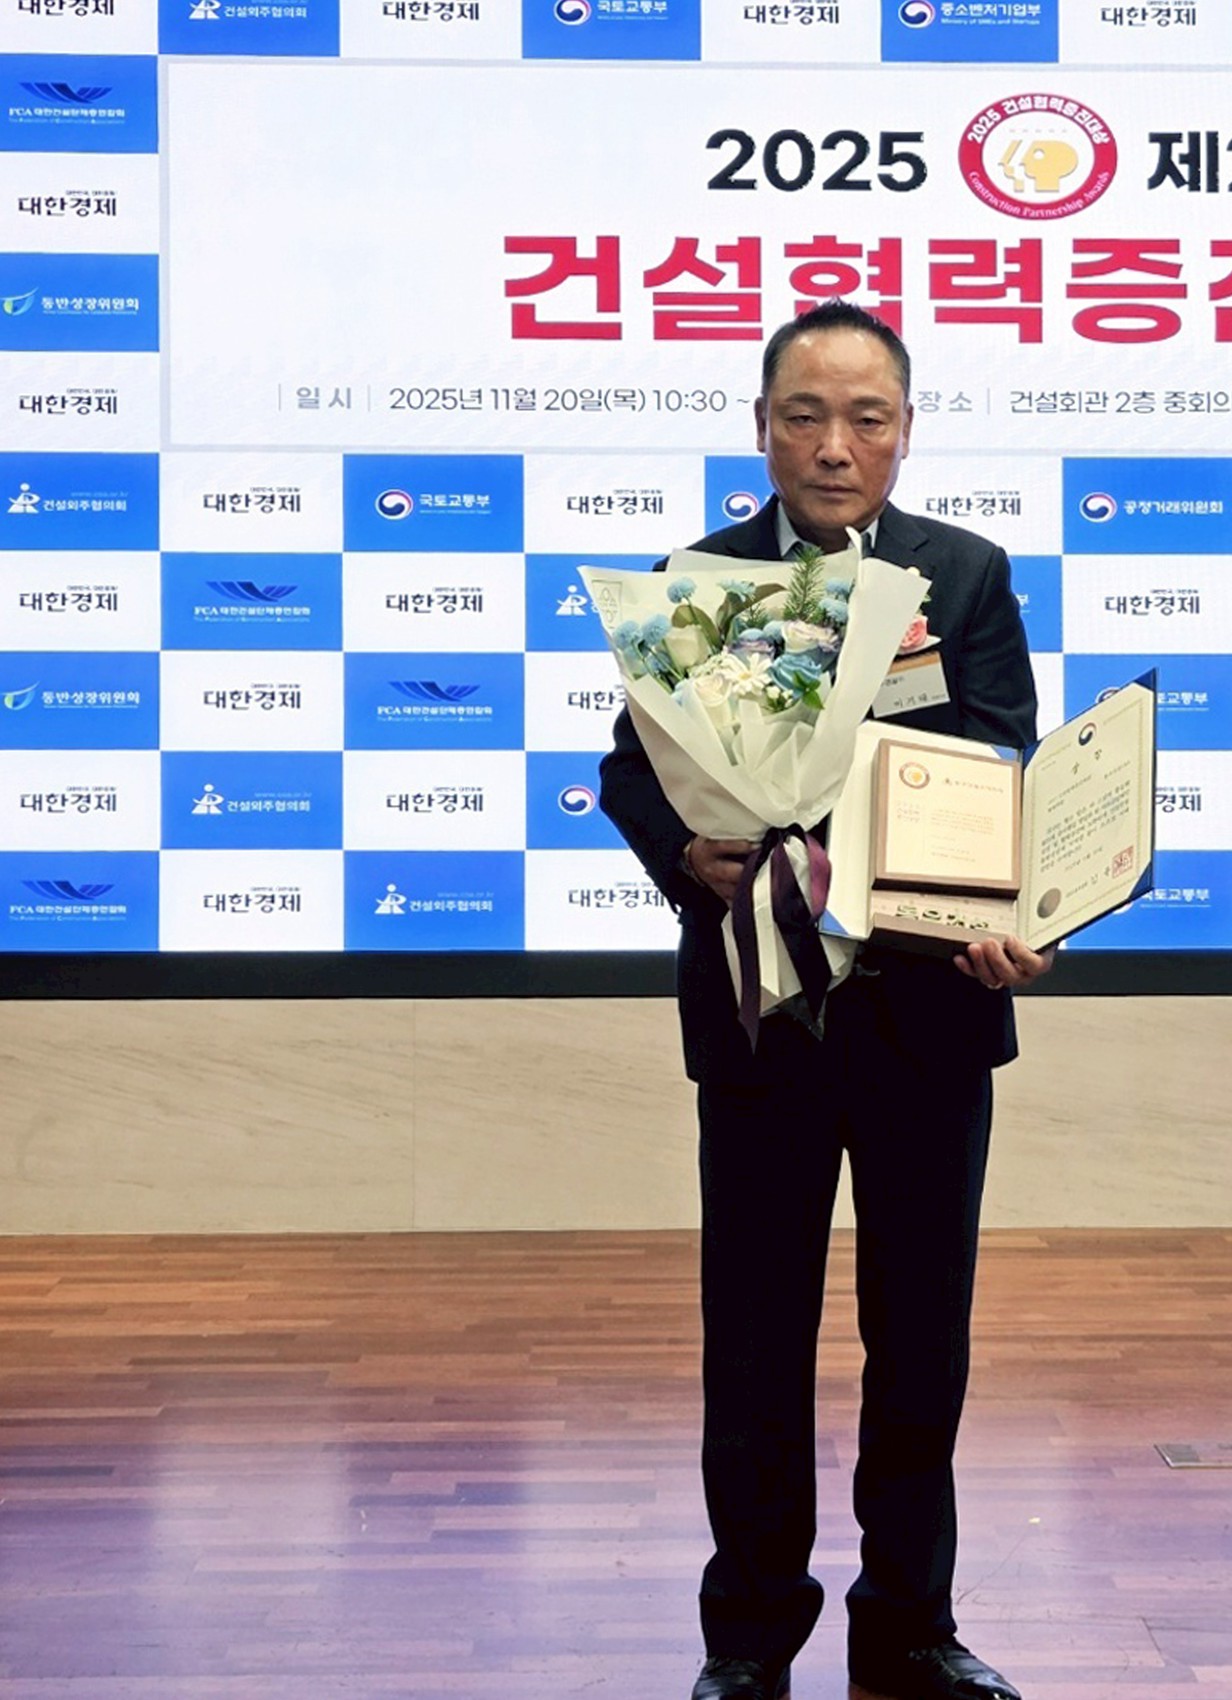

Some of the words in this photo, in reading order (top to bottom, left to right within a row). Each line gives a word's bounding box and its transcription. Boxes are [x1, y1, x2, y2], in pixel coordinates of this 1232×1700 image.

[19, 0, 113, 16] 대한경제
[224, 6, 307, 18] 건설외주협의회
[383, 3, 479, 21] 대한경제
[598, 0, 667, 13] 국토교통부
[744, 5, 839, 25] 대한경제
[941, 3, 1041, 16] 중소벤처기업부
[1102, 7, 1196, 26] 대한경제
[967, 108, 1001, 144] 2025
[1001, 95, 1110, 144] 건설협력증진대상
[706, 129, 927, 192] 2025
[970, 172, 1021, 215] Construction
[1022, 198, 1084, 217] Partnership
[1083, 171, 1110, 202] Awards
[19, 197, 116, 217] 대한경제
[42, 298, 139, 312] 동반성장위원회
[20, 395, 117, 415] 대한경제
[390, 388, 482, 410] 2025년
[491, 388, 536, 411] 11월
[544, 389, 645, 412] 20일(목)
[653, 390, 726, 412] 10:30
[1011, 391, 1108, 413] 건설회관
[1116, 391, 1154, 413] 2층
[44, 500, 126, 511] 건설외주협의회
[204, 494, 300, 513] 대한경제
[420, 494, 489, 507] 국토교통부
[566, 494, 664, 515] 대한경제
[926, 497, 1021, 517] 대한경제
[1124, 501, 1223, 514] 공정거래위원회
[20, 592, 117, 612] 대한경제
[194, 606, 218, 615] FCA
[386, 594, 482, 613] 대한경제
[1105, 596, 1199, 616] 대한경제
[43, 692, 140, 704] 동반성장위원회
[204, 691, 300, 710] 대한경제
[377, 706, 400, 715] FCA
[21, 794, 116, 813] 대한경제
[228, 801, 310, 811] 건설외주협의회
[387, 793, 483, 812] 대한경제
[10, 906, 33, 914] FCA
[204, 894, 300, 913] 대한경제
[409, 900, 493, 912] 건설외주협의회
